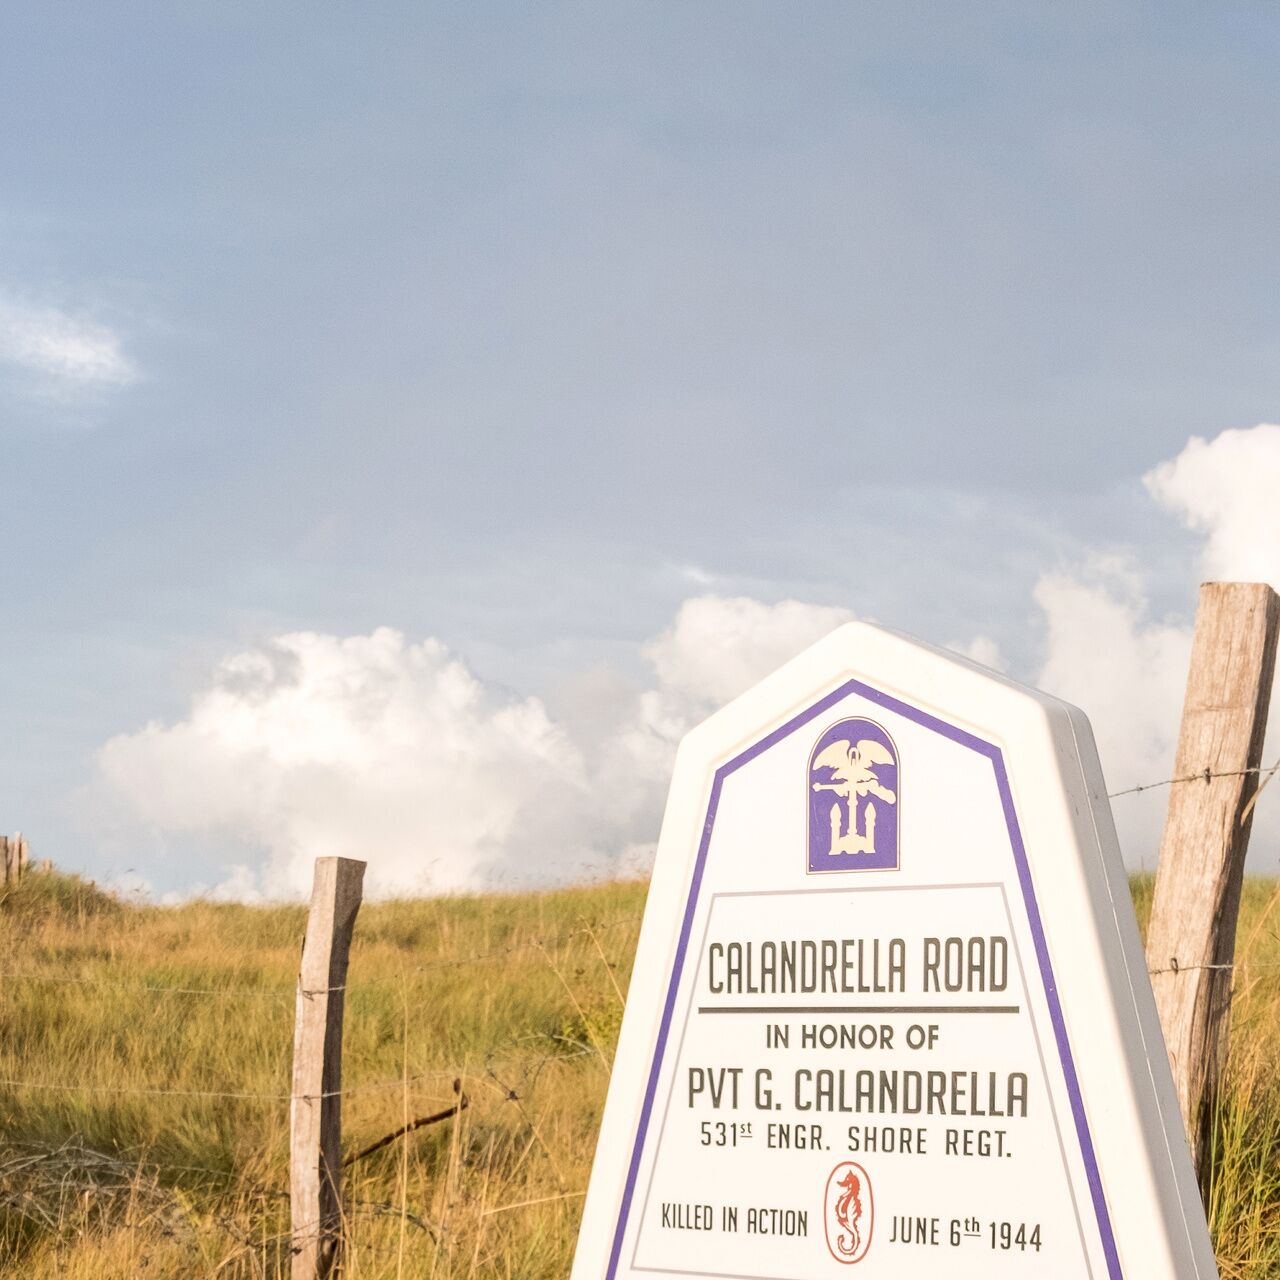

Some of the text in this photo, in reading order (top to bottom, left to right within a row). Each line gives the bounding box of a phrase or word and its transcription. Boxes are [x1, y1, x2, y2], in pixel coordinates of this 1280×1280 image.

[710, 936, 1007, 993] CALANDRELLA ROAD
[767, 1025, 938, 1049] IN HONOR OF
[689, 1068, 1027, 1117] PVT G. CALANDRELLA
[701, 1122, 1011, 1157] 531st ENGR. SHORE REGT.
[662, 1203, 1041, 1252] KILLED IN ACTION JUNE 6th 1944
